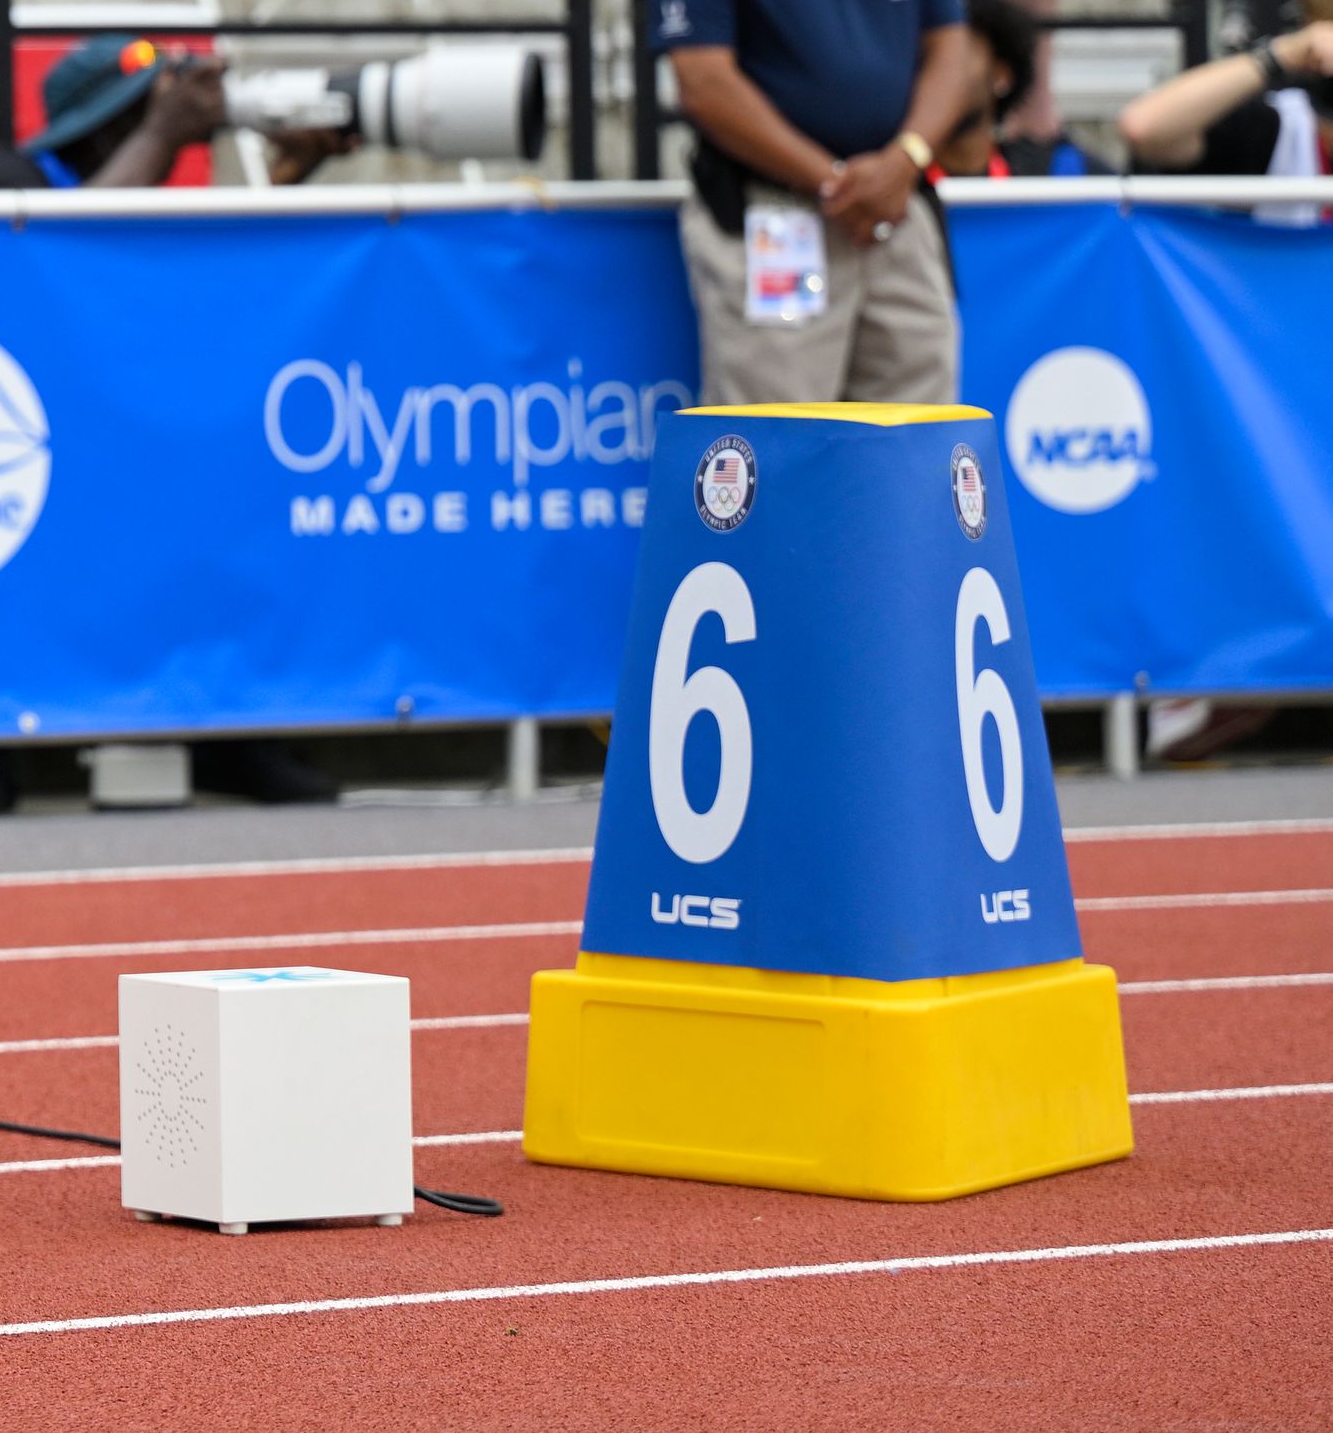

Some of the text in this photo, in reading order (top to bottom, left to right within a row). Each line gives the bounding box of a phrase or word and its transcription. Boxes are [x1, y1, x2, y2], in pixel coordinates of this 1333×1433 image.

[263, 356, 694, 494] Olympian
[1027, 427, 1141, 468] NCAA
[705, 437, 753, 463] UNITED STATES
[290, 486, 646, 536] MADE HERE
[649, 561, 757, 864] 6
[955, 566, 1024, 863] 6
[651, 891, 740, 929] UCS
[980, 889, 1030, 924] UCS
